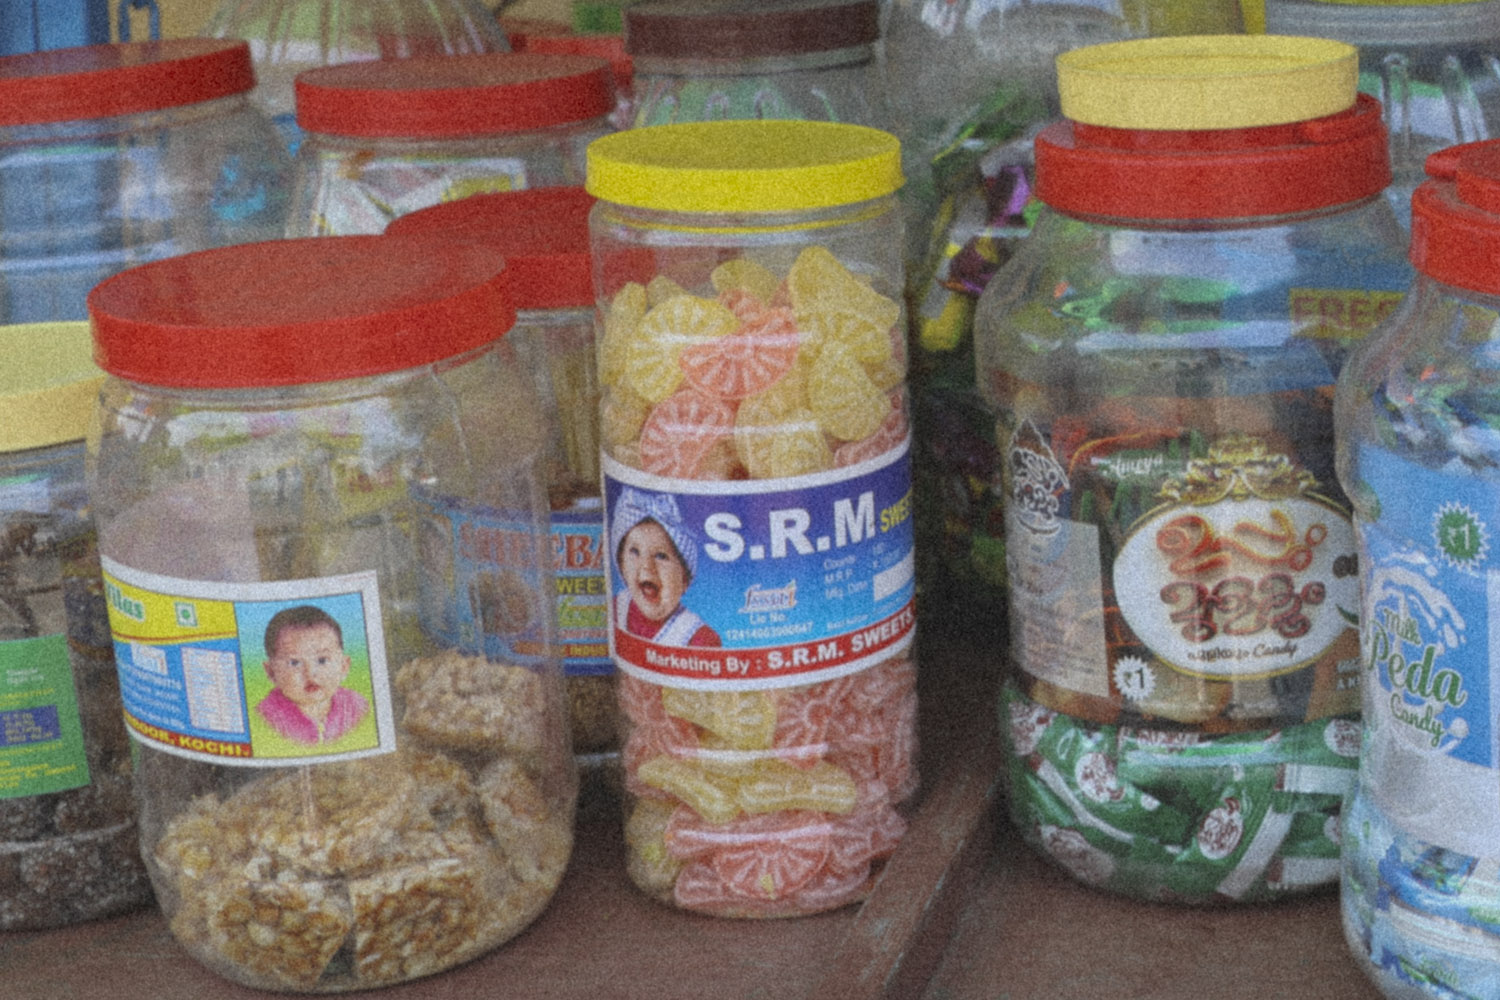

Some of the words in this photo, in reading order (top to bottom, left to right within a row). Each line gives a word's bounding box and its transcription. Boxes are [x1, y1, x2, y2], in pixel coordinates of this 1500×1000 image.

[645, 649, 721, 675] Marketing
[725, 655, 751, 675] By
[1366, 618, 1468, 708] Peda
[1389, 691, 1445, 749] Candy
